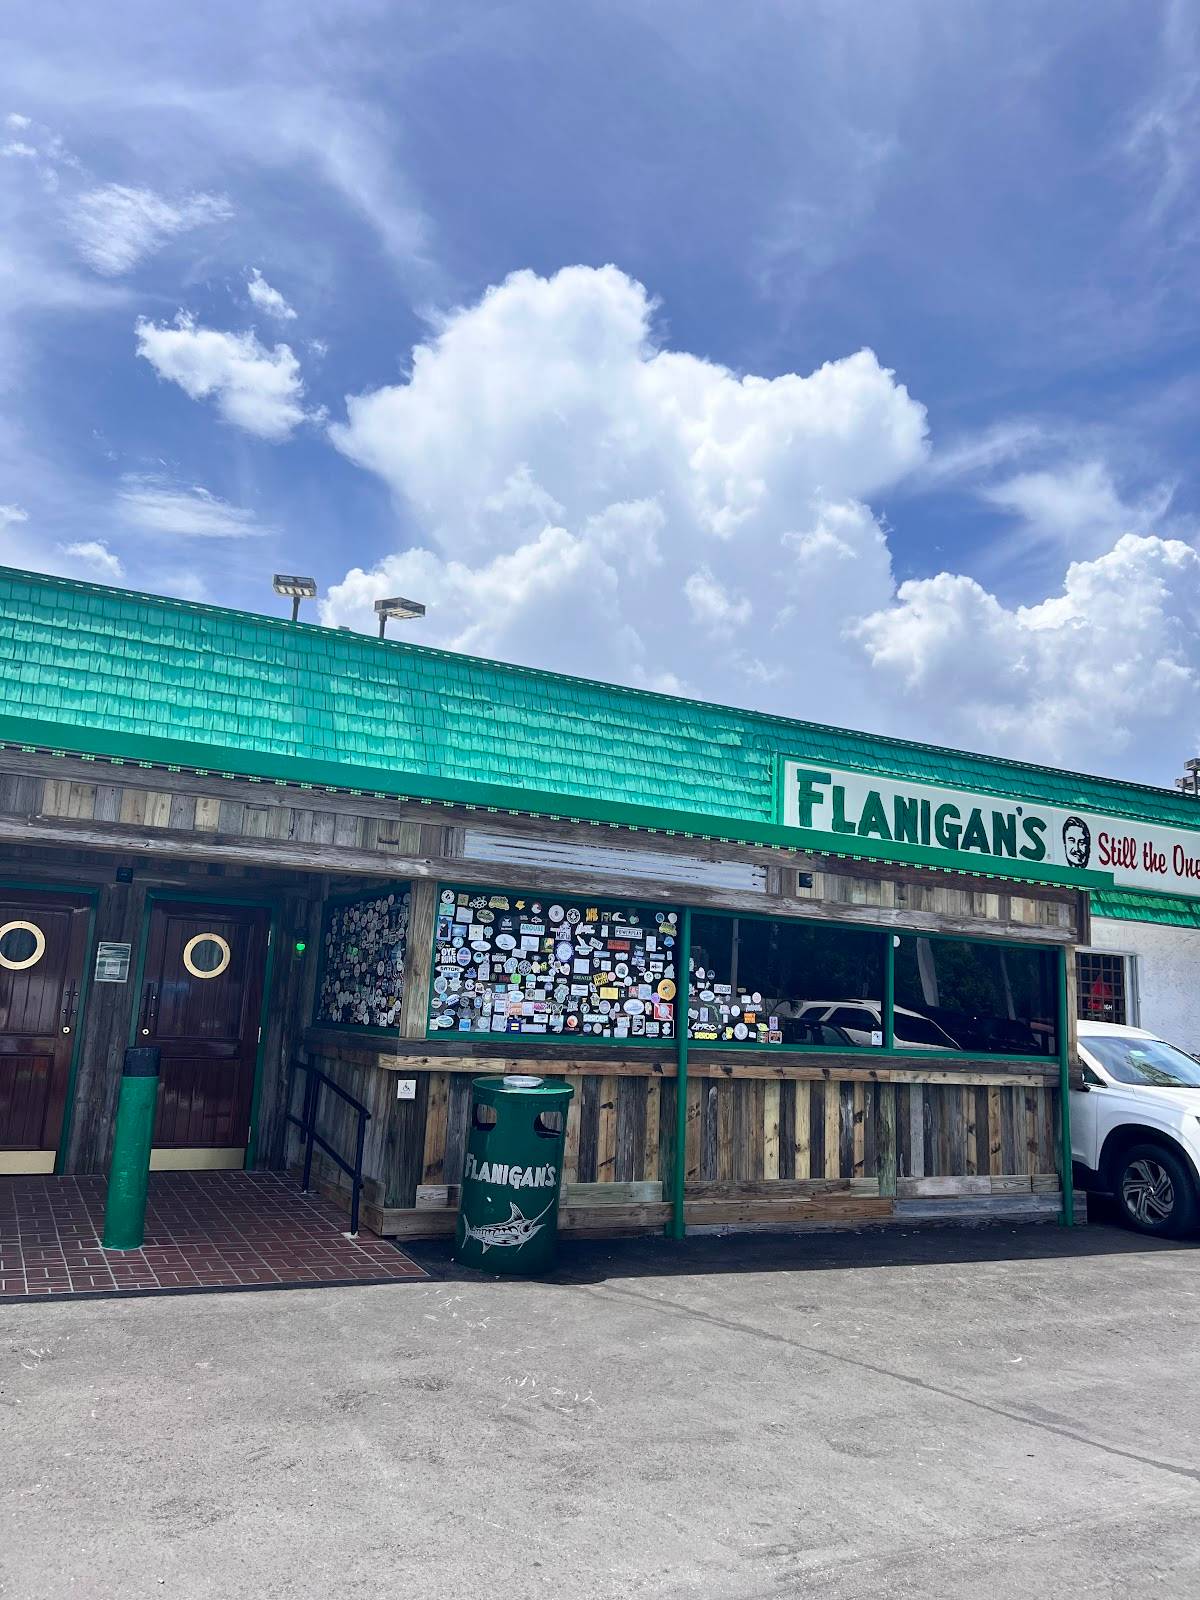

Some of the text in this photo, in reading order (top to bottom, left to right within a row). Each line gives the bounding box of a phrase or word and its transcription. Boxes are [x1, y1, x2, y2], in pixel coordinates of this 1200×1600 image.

[796, 768, 1047, 862] FLANIGAN'S
[1098, 832, 1138, 870] Still
[1143, 841, 1168, 874] the
[465, 1152, 556, 1190] FLANIGAN'S
